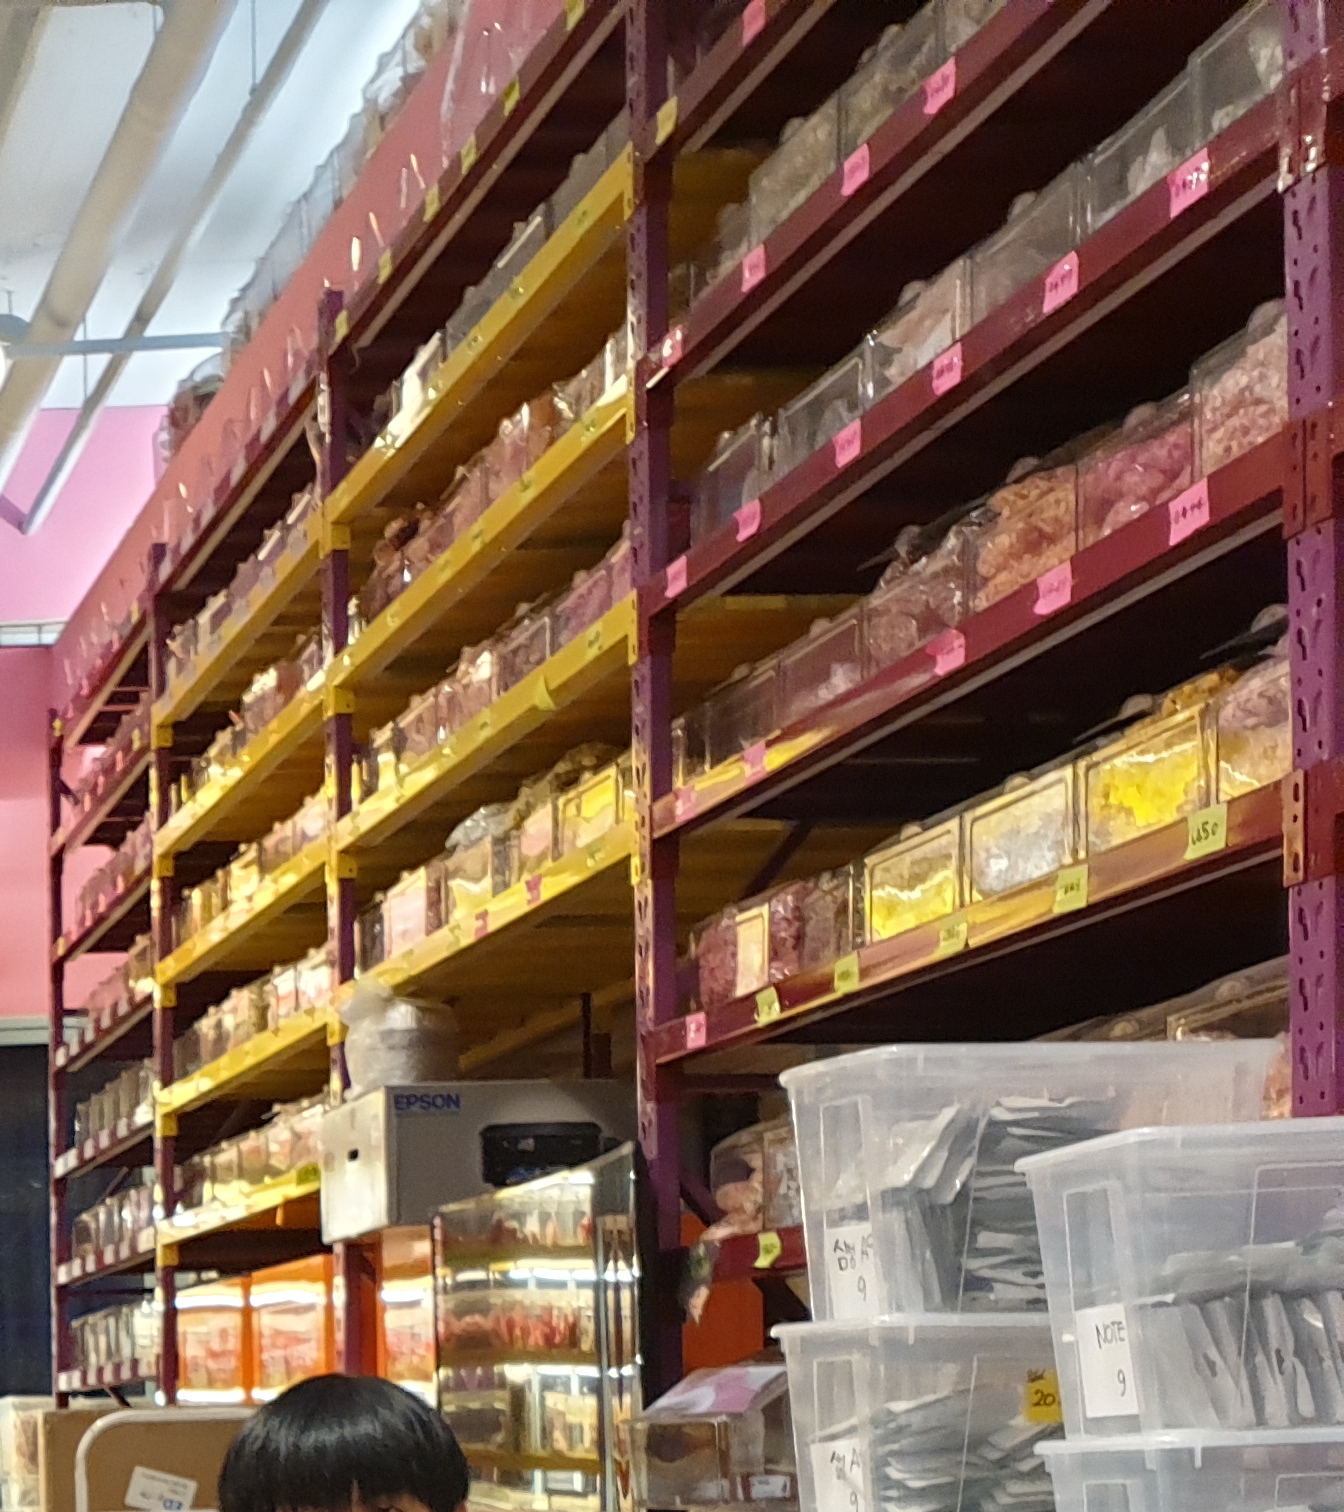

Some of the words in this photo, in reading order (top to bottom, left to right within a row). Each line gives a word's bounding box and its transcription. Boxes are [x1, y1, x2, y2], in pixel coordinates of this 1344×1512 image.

[393, 1092, 461, 1112] EPSON
[1117, 1368, 1127, 1397] 9
[1032, 1388, 1056, 1407] 20
